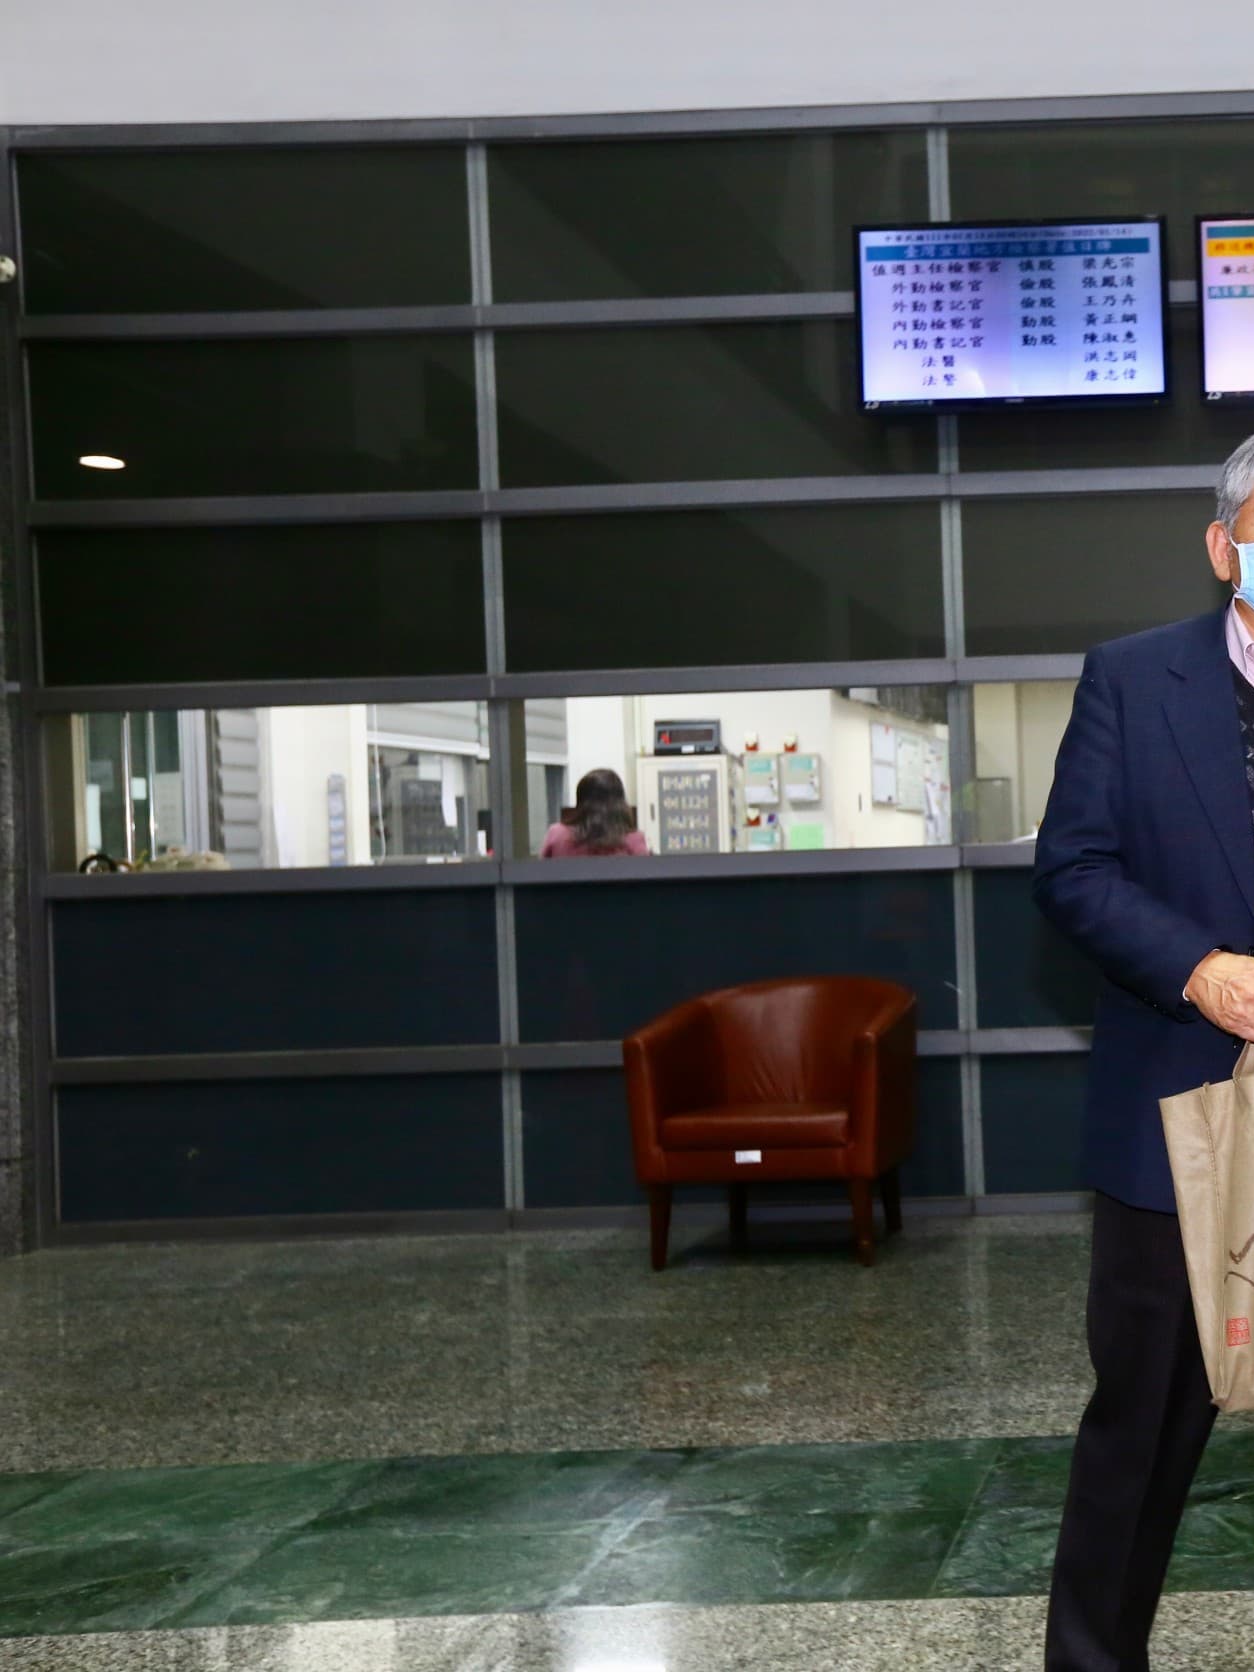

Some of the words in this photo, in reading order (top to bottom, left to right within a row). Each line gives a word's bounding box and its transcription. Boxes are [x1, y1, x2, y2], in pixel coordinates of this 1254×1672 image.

[891, 279, 983, 295] 外勤檢察官
[891, 298, 984, 313] 外勤書記官
[921, 354, 956, 369] 法醫
